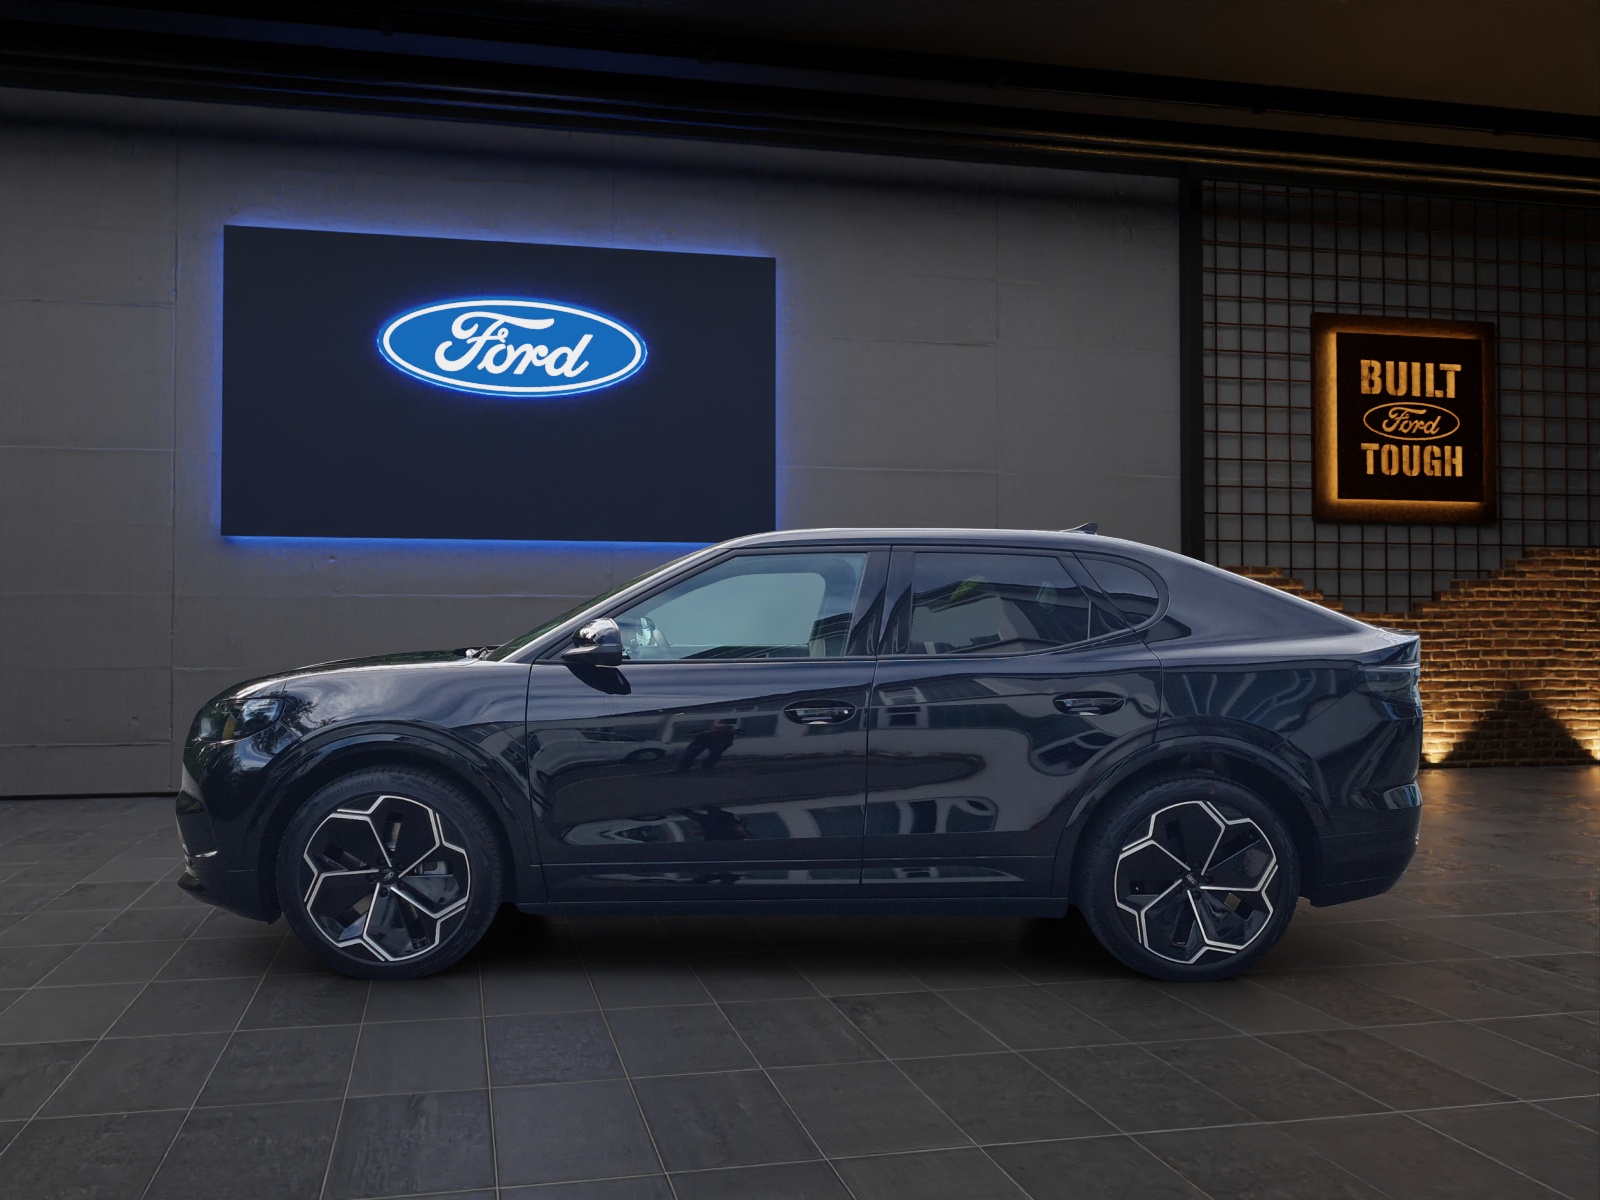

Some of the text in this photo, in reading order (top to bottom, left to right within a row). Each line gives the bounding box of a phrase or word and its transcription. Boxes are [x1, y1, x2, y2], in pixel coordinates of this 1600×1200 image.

[434, 311, 594, 378] Ford
[1360, 359, 1462, 399] BUILT
[1382, 406, 1442, 434] Ford
[1360, 443, 1463, 478] TOUGH
